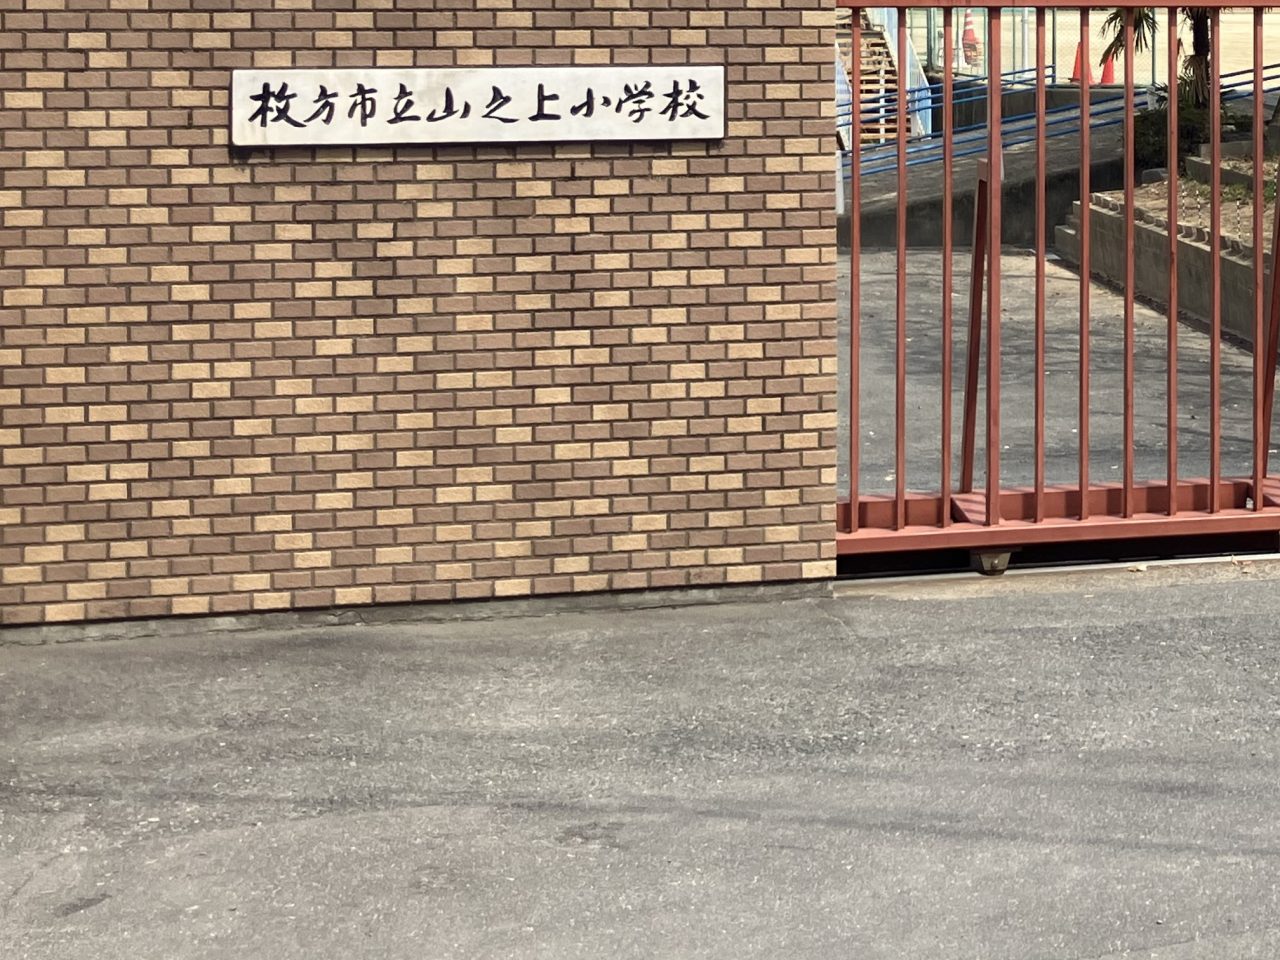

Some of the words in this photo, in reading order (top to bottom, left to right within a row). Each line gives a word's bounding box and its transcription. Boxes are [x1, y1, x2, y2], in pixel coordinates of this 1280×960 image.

[248, 78, 711, 128] 枚方市立山之上小学校
